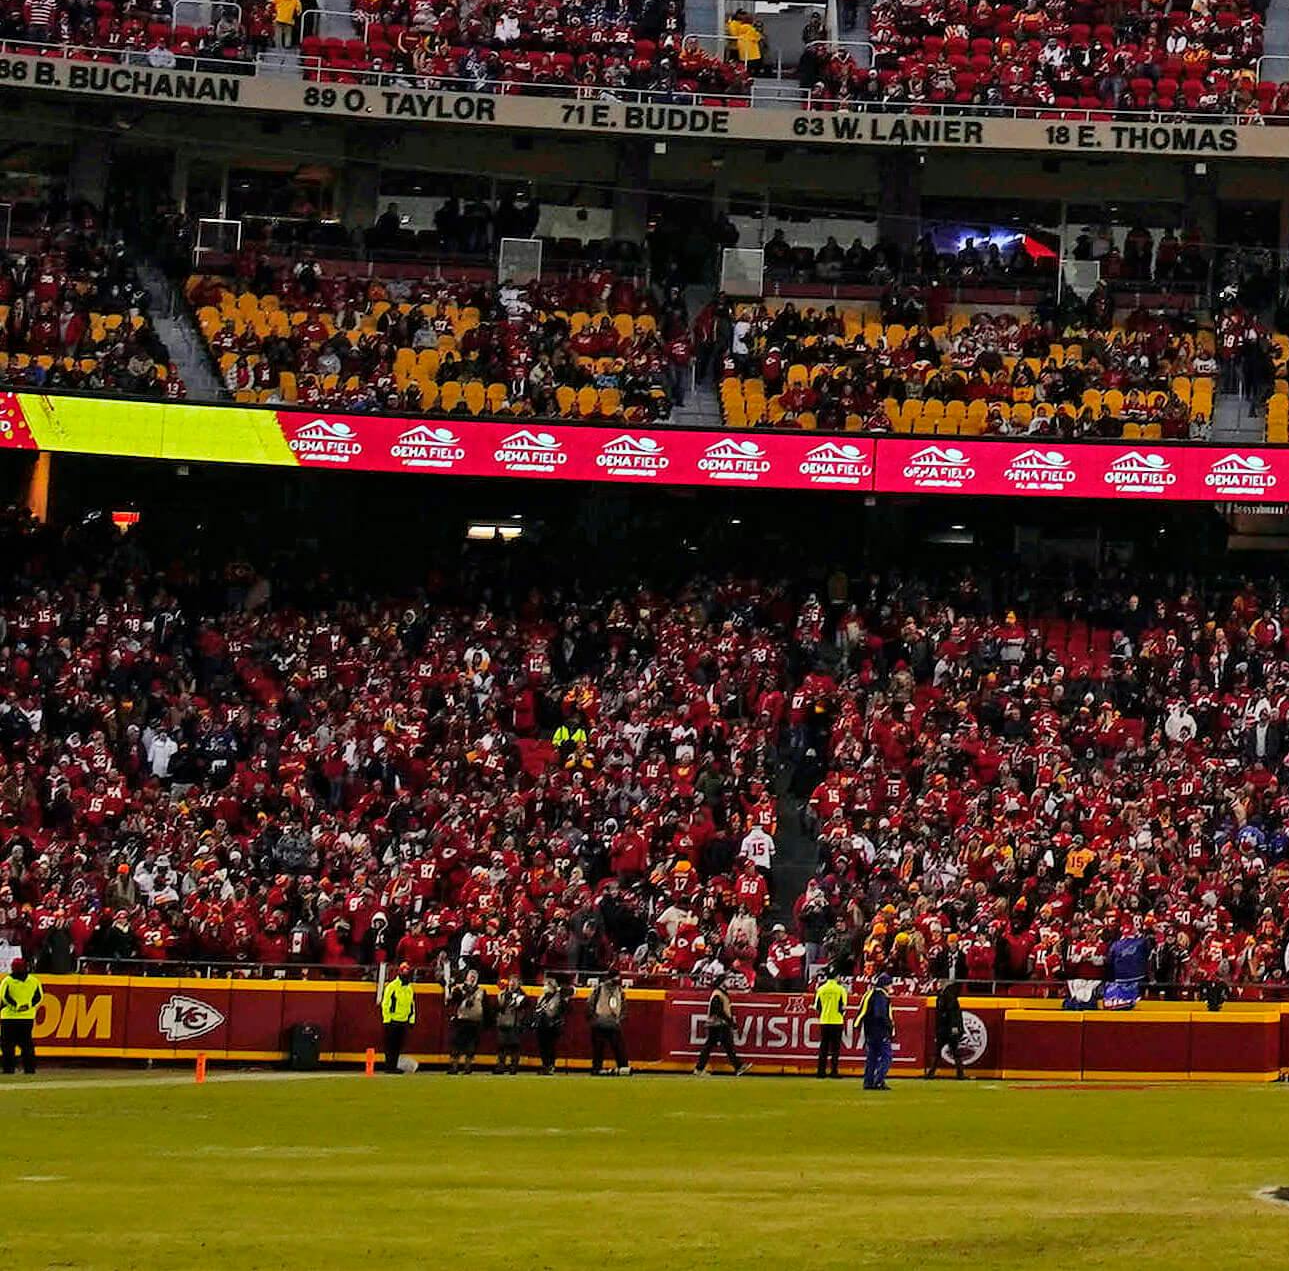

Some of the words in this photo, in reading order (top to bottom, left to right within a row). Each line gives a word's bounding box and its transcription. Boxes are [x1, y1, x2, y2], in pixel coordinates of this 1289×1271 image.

[0, 59, 27, 81] 86
[34, 61, 60, 87] B.
[69, 66, 239, 103] BUCHANAN
[303, 87, 337, 107] 89
[343, 90, 373, 114] O.
[382, 91, 496, 121] TAYLOR
[561, 104, 583, 124] 71
[591, 106, 616, 128] E.
[625, 106, 729, 134] BUDDE
[793, 116, 825, 136] 63
[832, 117, 863, 139] W.
[871, 117, 984, 144] LANIER
[1046, 125, 1069, 145] 18
[1077, 126, 1101, 148] E.
[1111, 127, 1238, 151] THOMAS
[289, 440, 326, 452] GEHA
[327, 442, 362, 455] FIELD
[390, 445, 428, 458] GEHA
[429, 447, 465, 460] FIELD
[494, 450, 531, 463] GEHA
[532, 452, 567, 464] FIELD
[596, 455, 633, 467] GEHA
[633, 457, 669, 469] FIELD
[698, 459, 734, 471] GEHA
[735, 460, 770, 472] FIELD
[799, 462, 836, 474] GEHA
[837, 463, 872, 476] FIELD
[1104, 472, 1141, 483] GEHA
[1141, 473, 1176, 485] FIELD
[1204, 473, 1241, 485] GEHA
[1242, 474, 1277, 487] FIELD
[312, 666, 327, 678] 56
[828, 789, 839, 802] 15
[1181, 783, 1193, 795] 10
[759, 812, 770, 823] 15
[753, 843, 764, 855] 15
[1072, 857, 1084, 867] 15
[421, 864, 434, 878] 87
[676, 877, 687, 890] 17
[742, 881, 757, 893] 68
